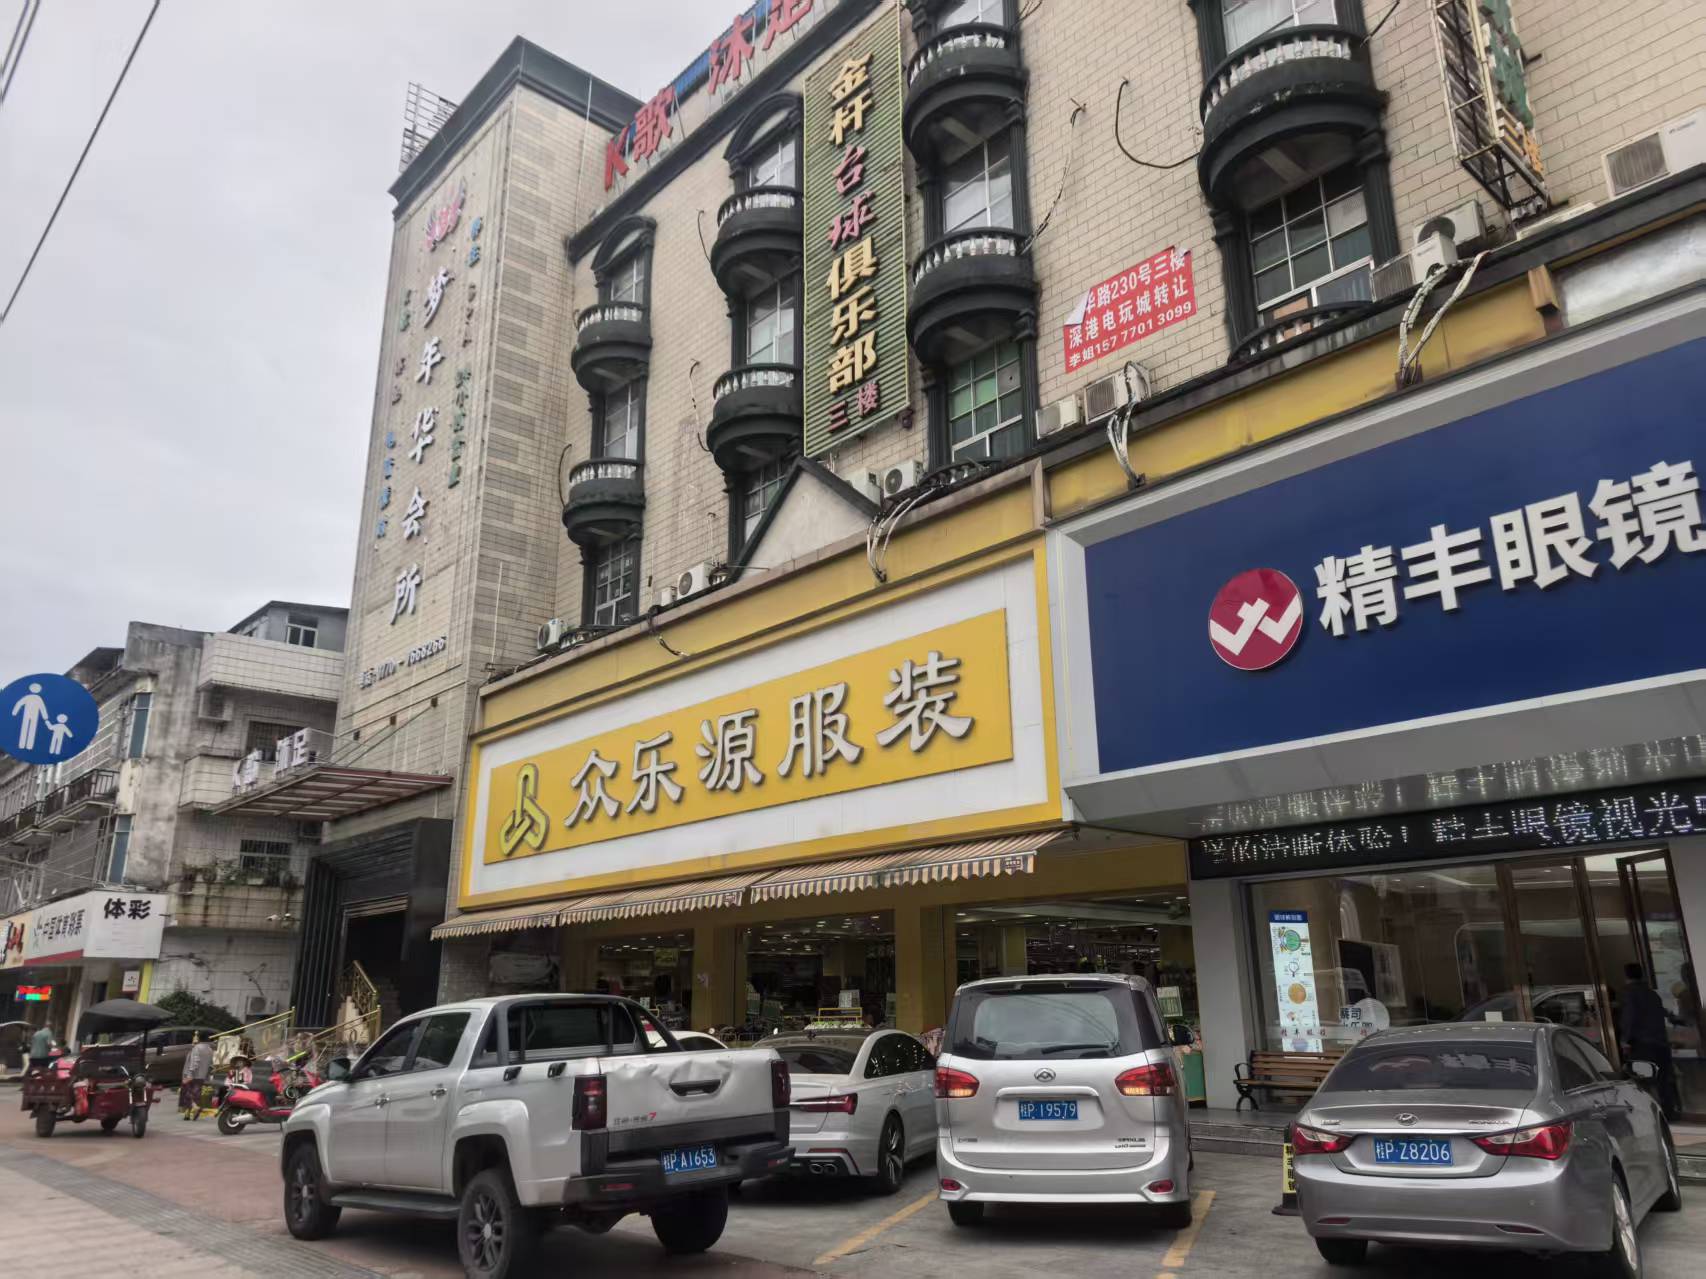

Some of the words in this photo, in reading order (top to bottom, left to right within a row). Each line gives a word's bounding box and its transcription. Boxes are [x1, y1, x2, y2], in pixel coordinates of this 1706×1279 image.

[1070, 275, 1188, 349] 深港电玩城转让
[391, 266, 454, 625] 梦年华会所
[827, 380, 880, 433] 三楼
[1314, 460, 1706, 637] 精丰眼镜
[564, 651, 975, 828] 众乐源服装
[104, 898, 151, 919] 体彩
